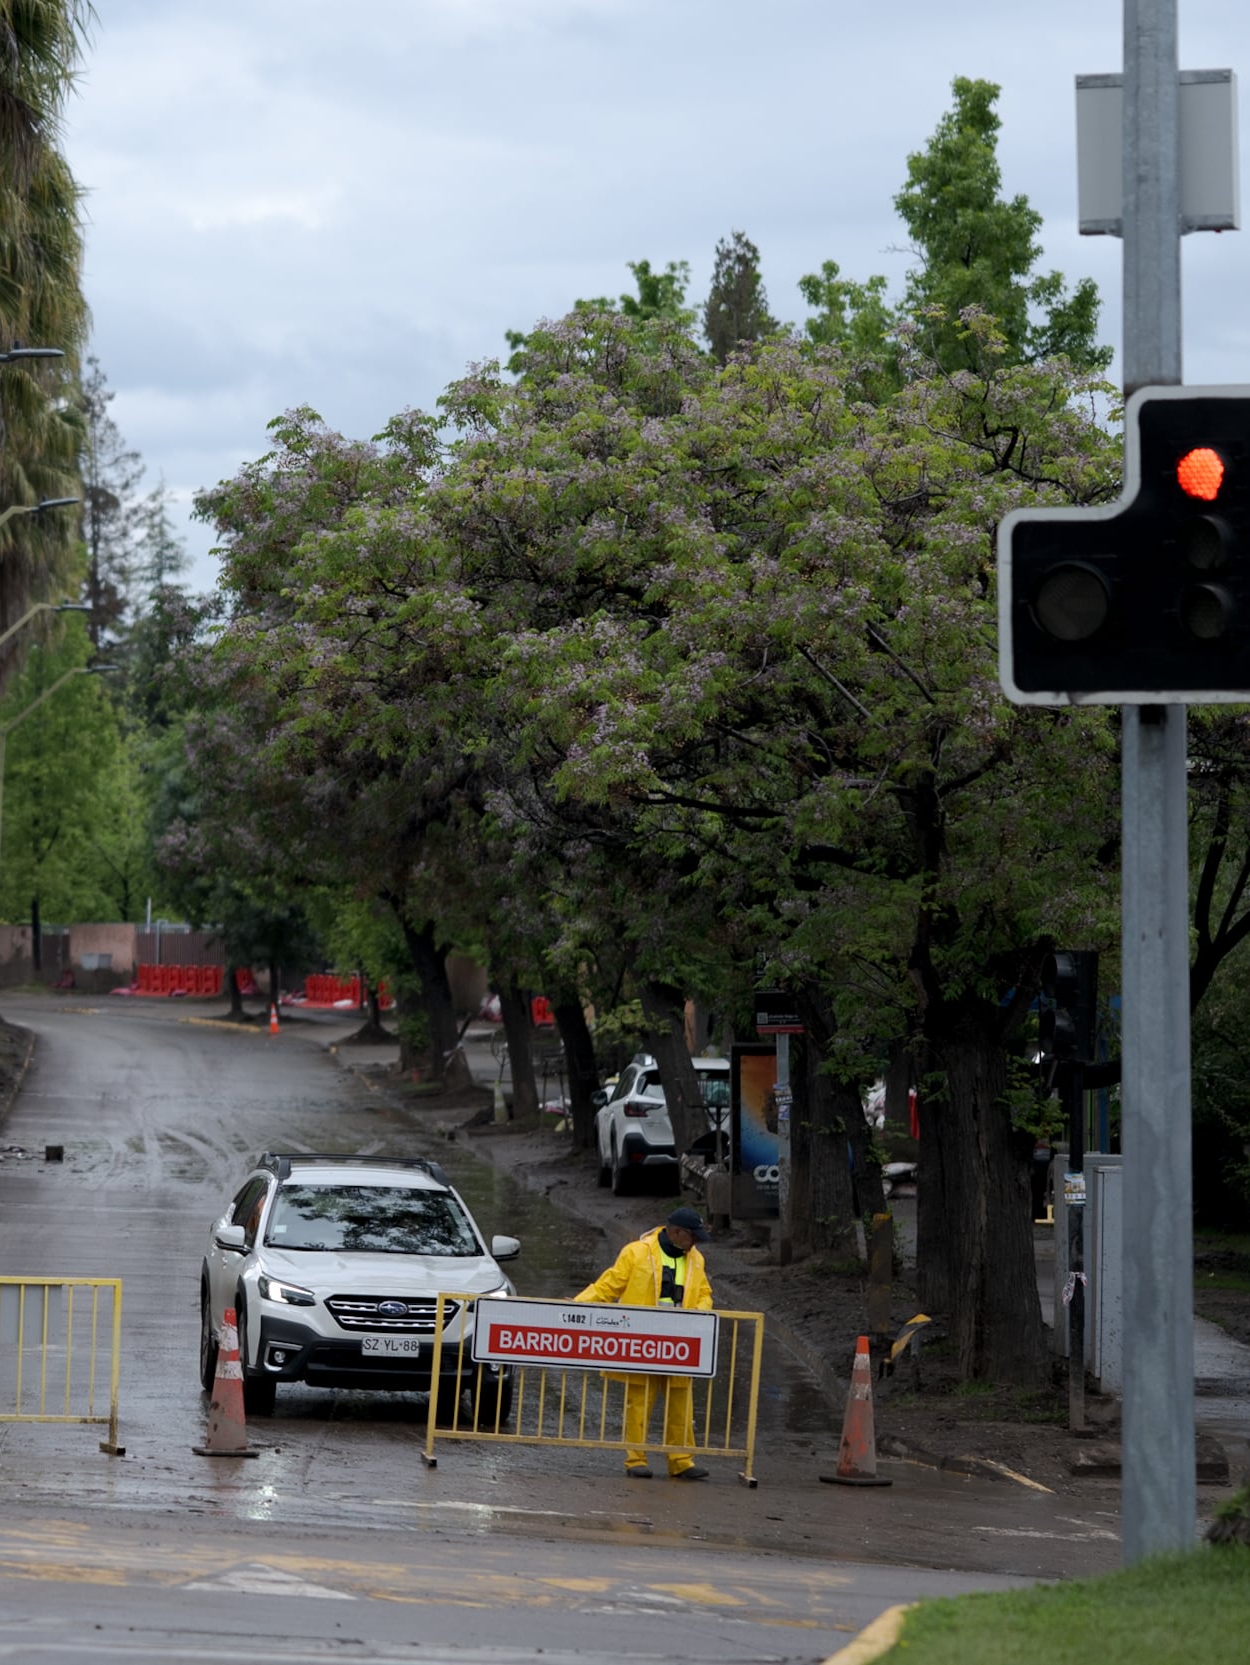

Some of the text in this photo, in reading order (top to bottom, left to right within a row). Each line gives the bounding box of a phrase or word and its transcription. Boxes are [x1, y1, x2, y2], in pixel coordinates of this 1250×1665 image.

[567, 1313, 586, 1324] 1402
[499, 1330, 690, 1361] BARRIO PROTEGIDO
